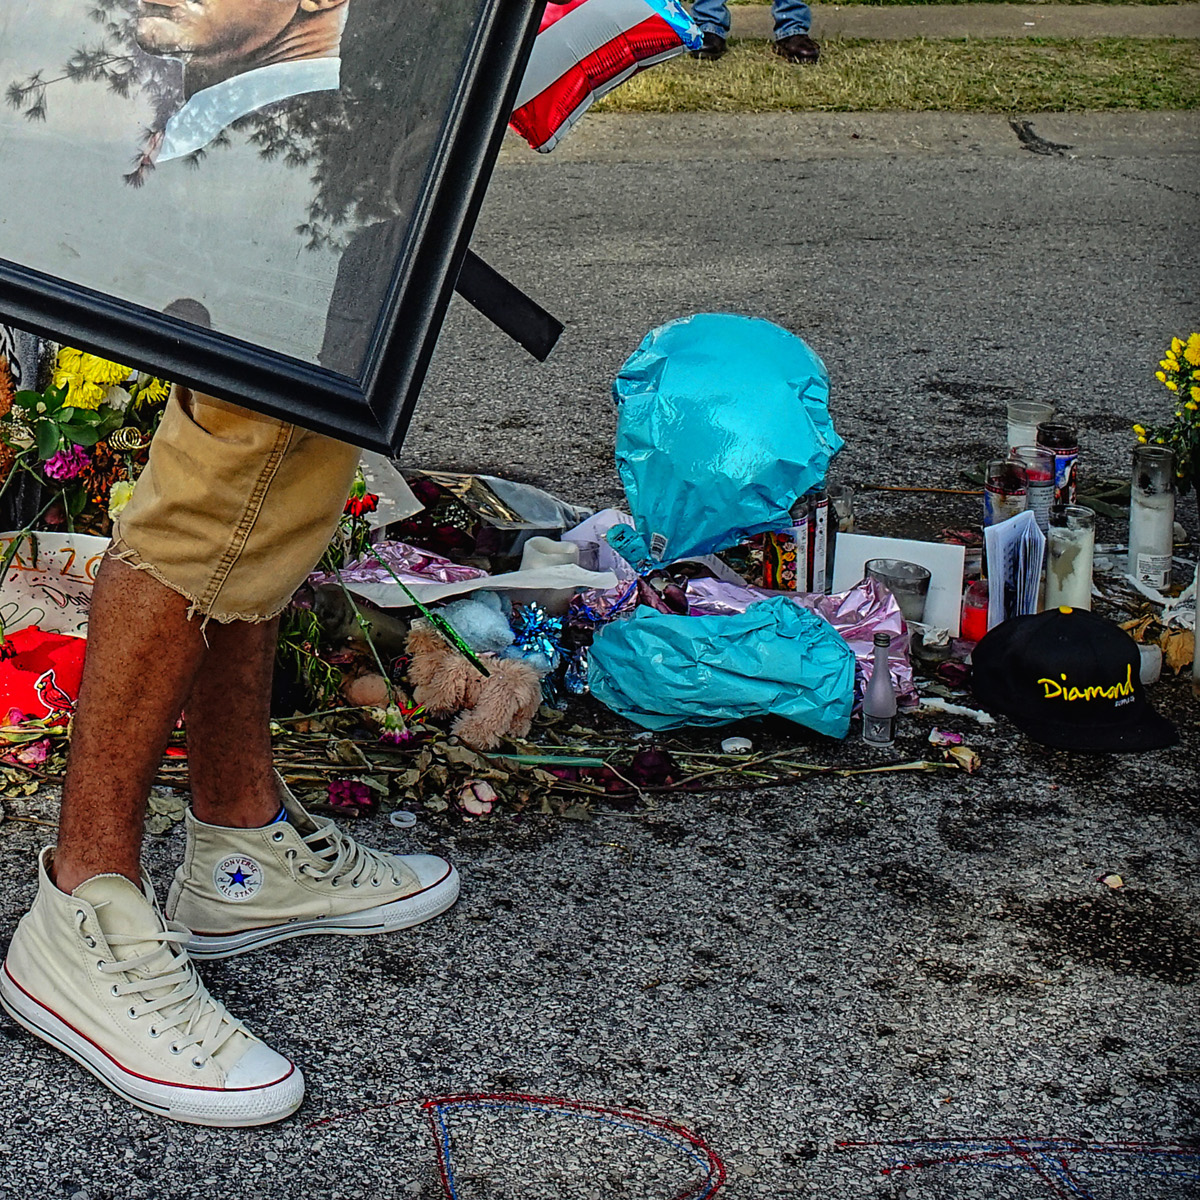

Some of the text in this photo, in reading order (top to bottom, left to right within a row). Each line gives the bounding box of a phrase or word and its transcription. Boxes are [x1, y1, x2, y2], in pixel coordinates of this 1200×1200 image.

[1037, 663, 1134, 701] Diamond
[220, 859, 258, 874] CONVERSE
[220, 884, 254, 898] ALL STAR
